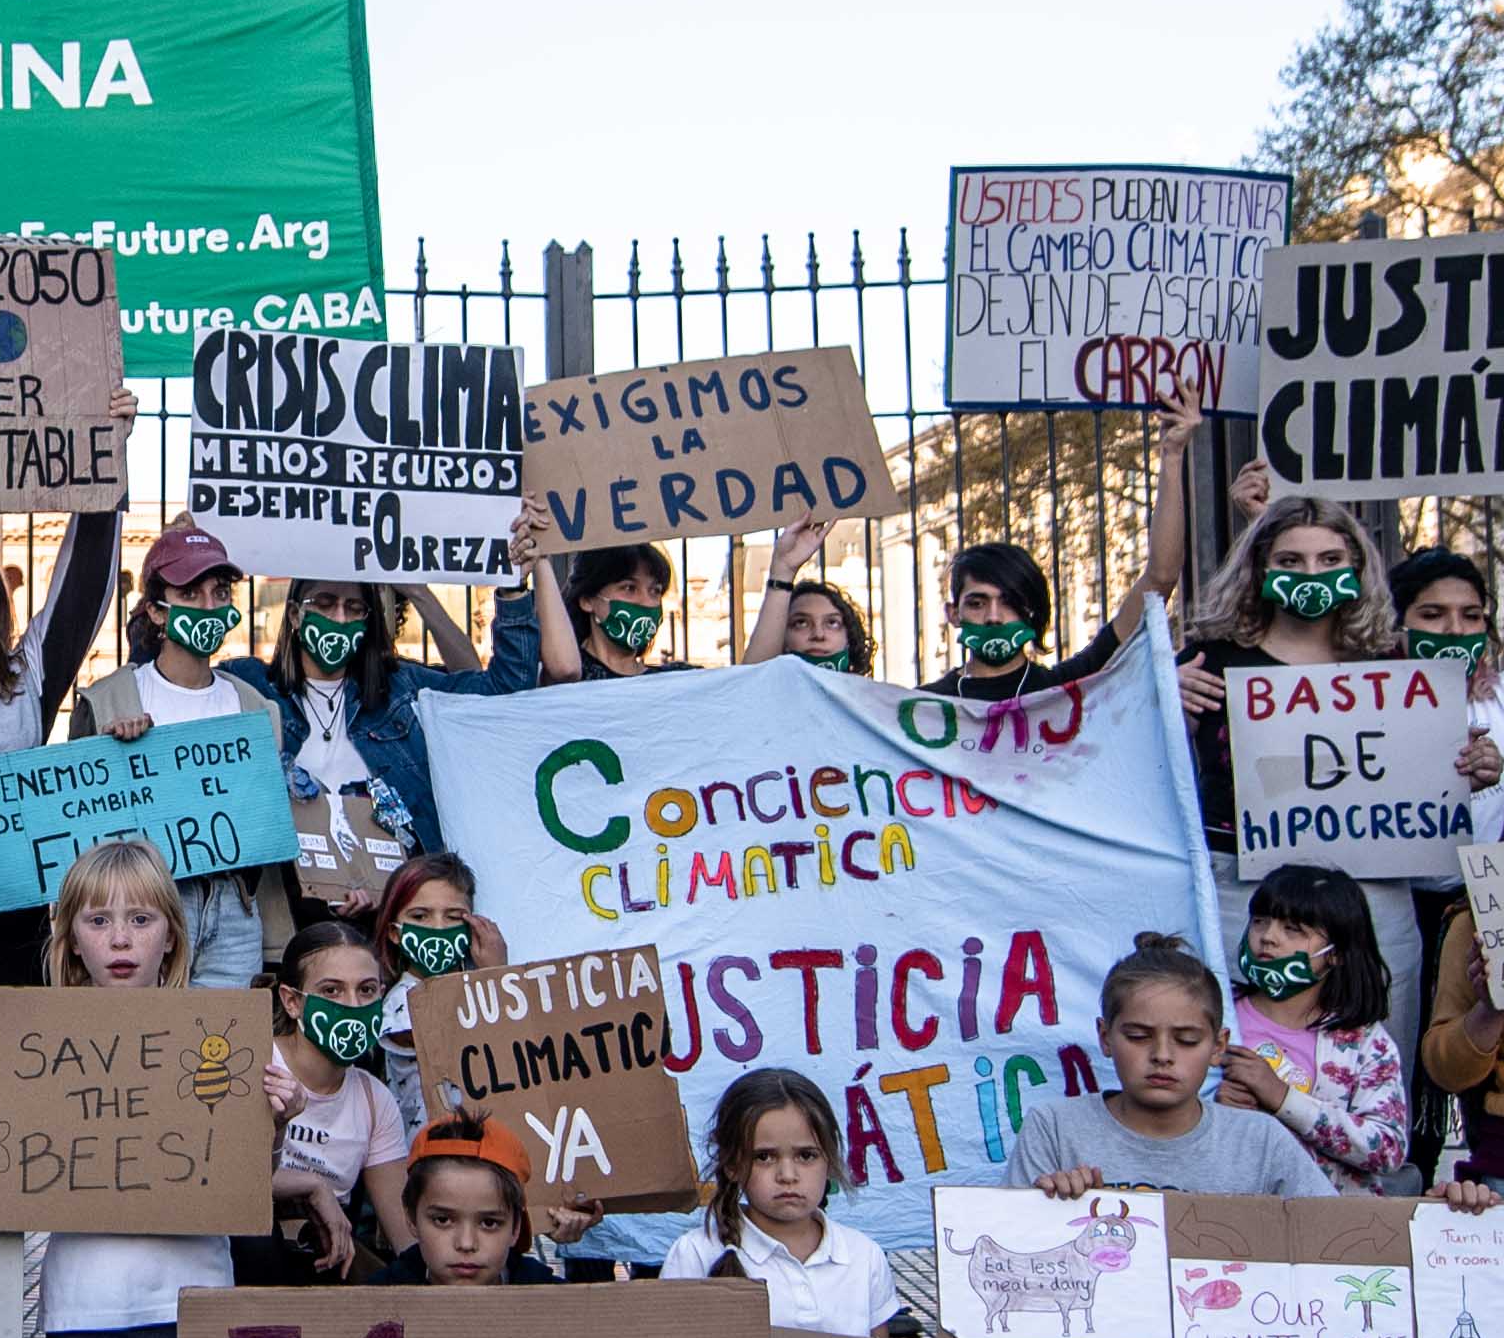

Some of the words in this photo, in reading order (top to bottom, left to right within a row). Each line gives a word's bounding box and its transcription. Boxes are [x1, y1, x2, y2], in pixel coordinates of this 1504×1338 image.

[959, 175, 1084, 225] USTEDES
[1091, 176, 1178, 224] PUEDEN
[1185, 178, 1285, 231] DETENER
[1084, 272, 1131, 337] DE
[193, 330, 346, 438] CRISIS
[353, 344, 524, 451] CLIMA
[1019, 340, 1069, 401] EL
[193, 438, 328, 478] MENOS
[345, 448, 518, 491] RECURSOS
[652, 428, 706, 460] LA
[547, 456, 867, 541] VERDAD
[1246, 669, 1440, 722] BASTA
[129, 753, 159, 781] EL
[174, 736, 252, 771] PODER
[1304, 731, 1386, 791] DE
[202, 775, 229, 797] EL
[1467, 853, 1500, 879] LA
[1474, 891, 1501, 915] LA
[15, 1030, 171, 1079] SAVE
[66, 1086, 151, 1120] THE
[18, 1127, 214, 1194] BEES!
[524, 1106, 612, 1184] YA
[1440, 1227, 1483, 1247] Turn
[1030, 1258, 1069, 1274] less
[1049, 1276, 1092, 1302] dairy
[1250, 1291, 1326, 1327] OUR
